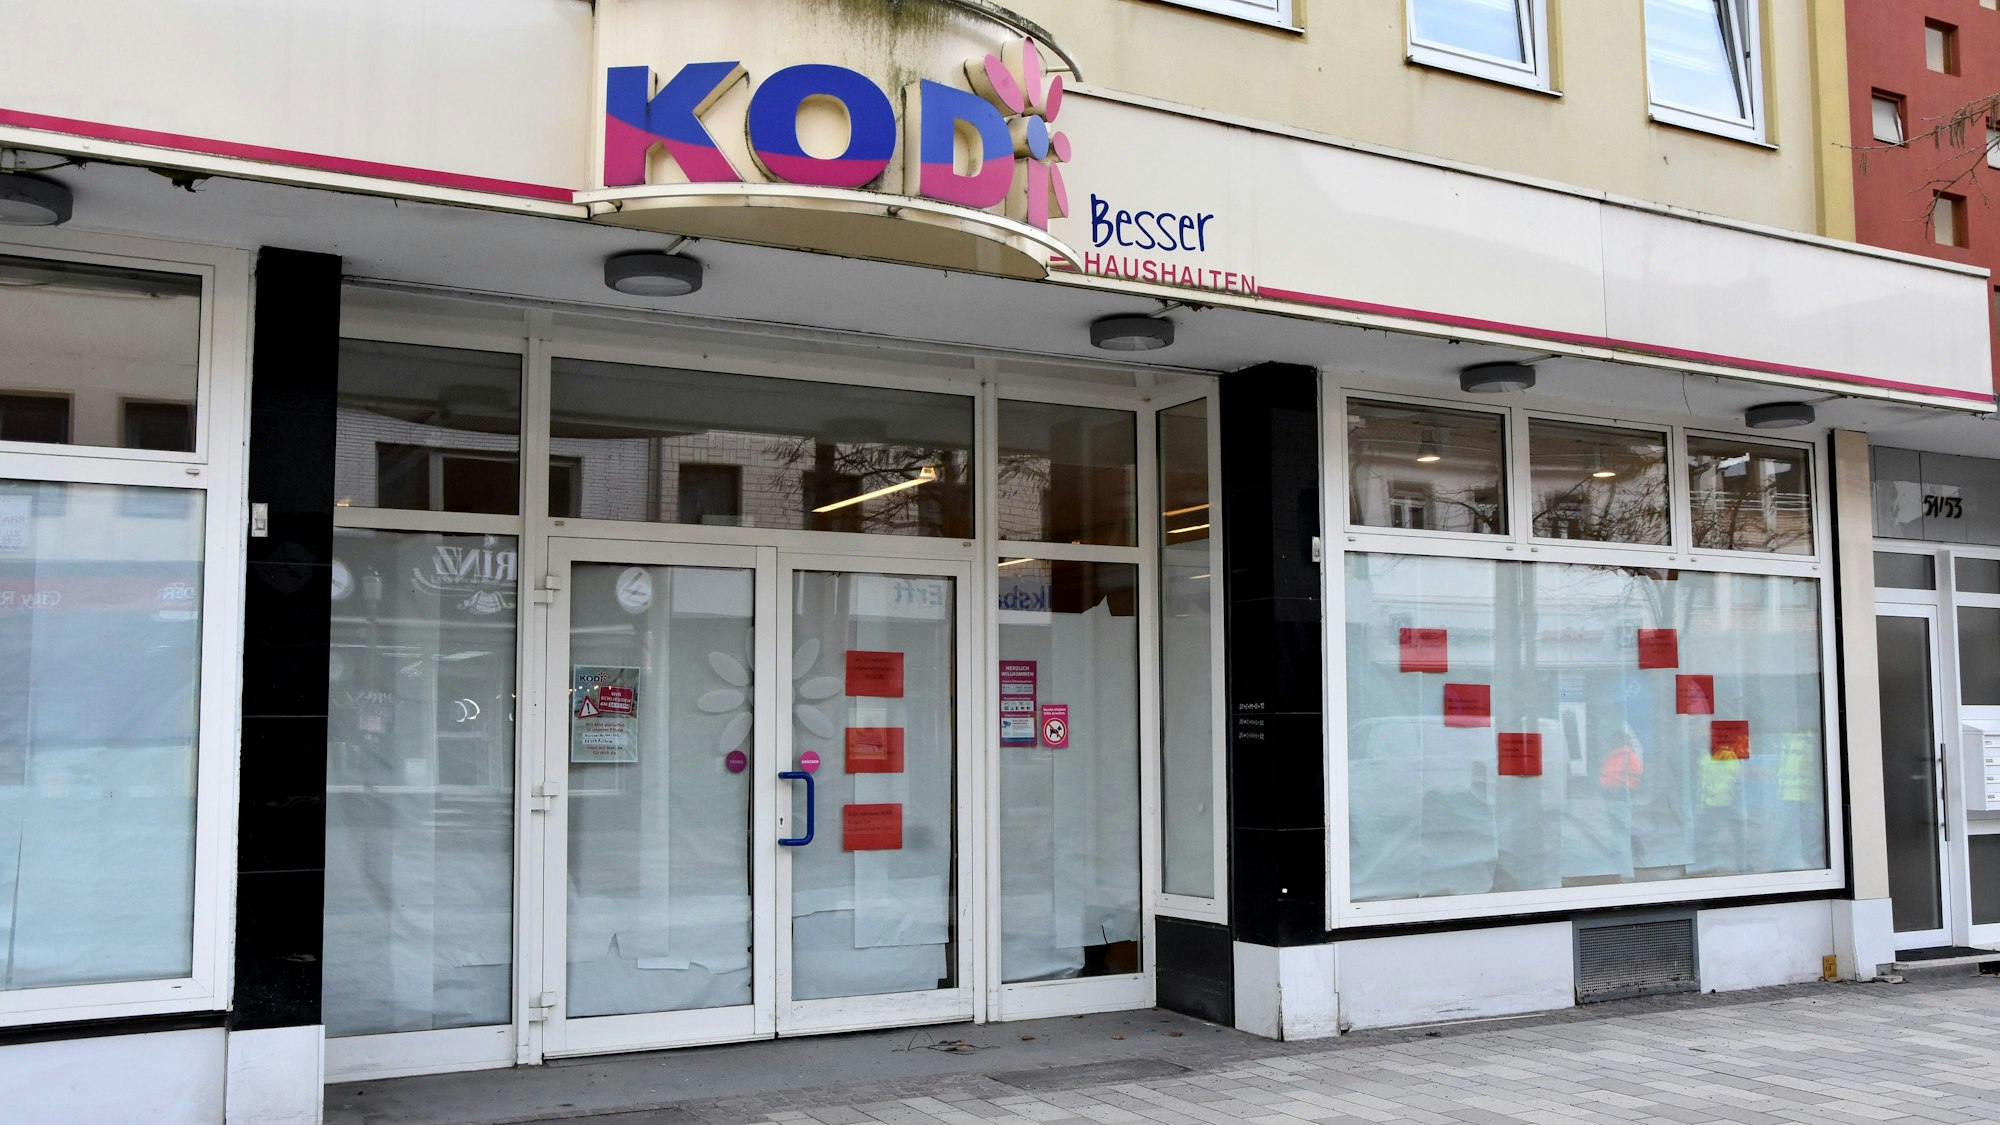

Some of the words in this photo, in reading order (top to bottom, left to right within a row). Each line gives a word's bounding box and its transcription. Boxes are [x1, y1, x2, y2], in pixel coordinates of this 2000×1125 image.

[1090, 193, 1214, 251] Besser
[1084, 251, 1257, 295] HAUSHALTEN
[1923, 494, 1963, 519] 51/53
[600, 695, 631, 703] SCHLIESSEN
